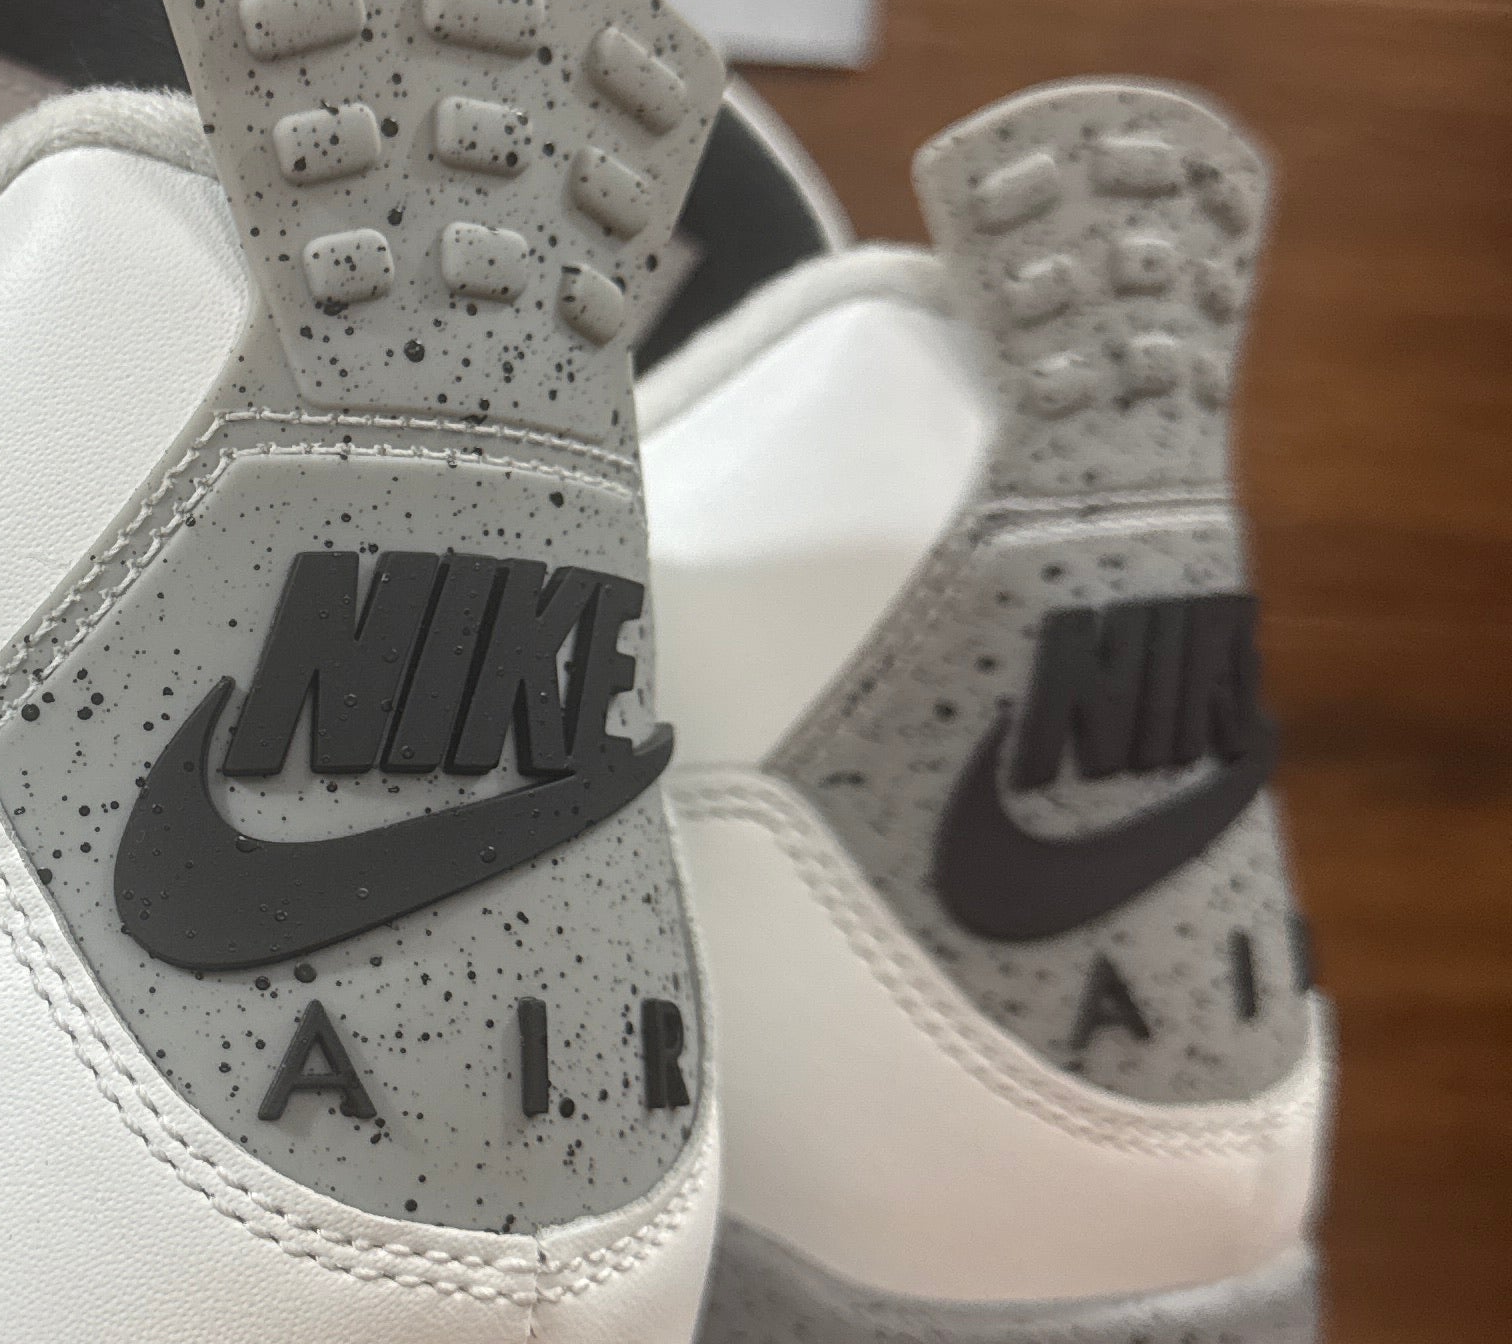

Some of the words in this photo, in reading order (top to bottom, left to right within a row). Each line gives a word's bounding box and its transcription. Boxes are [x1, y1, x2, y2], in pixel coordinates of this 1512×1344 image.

[221, 550, 645, 776] NIKE
[1066, 908, 1314, 1048] AI
[257, 996, 690, 1121] AIR
